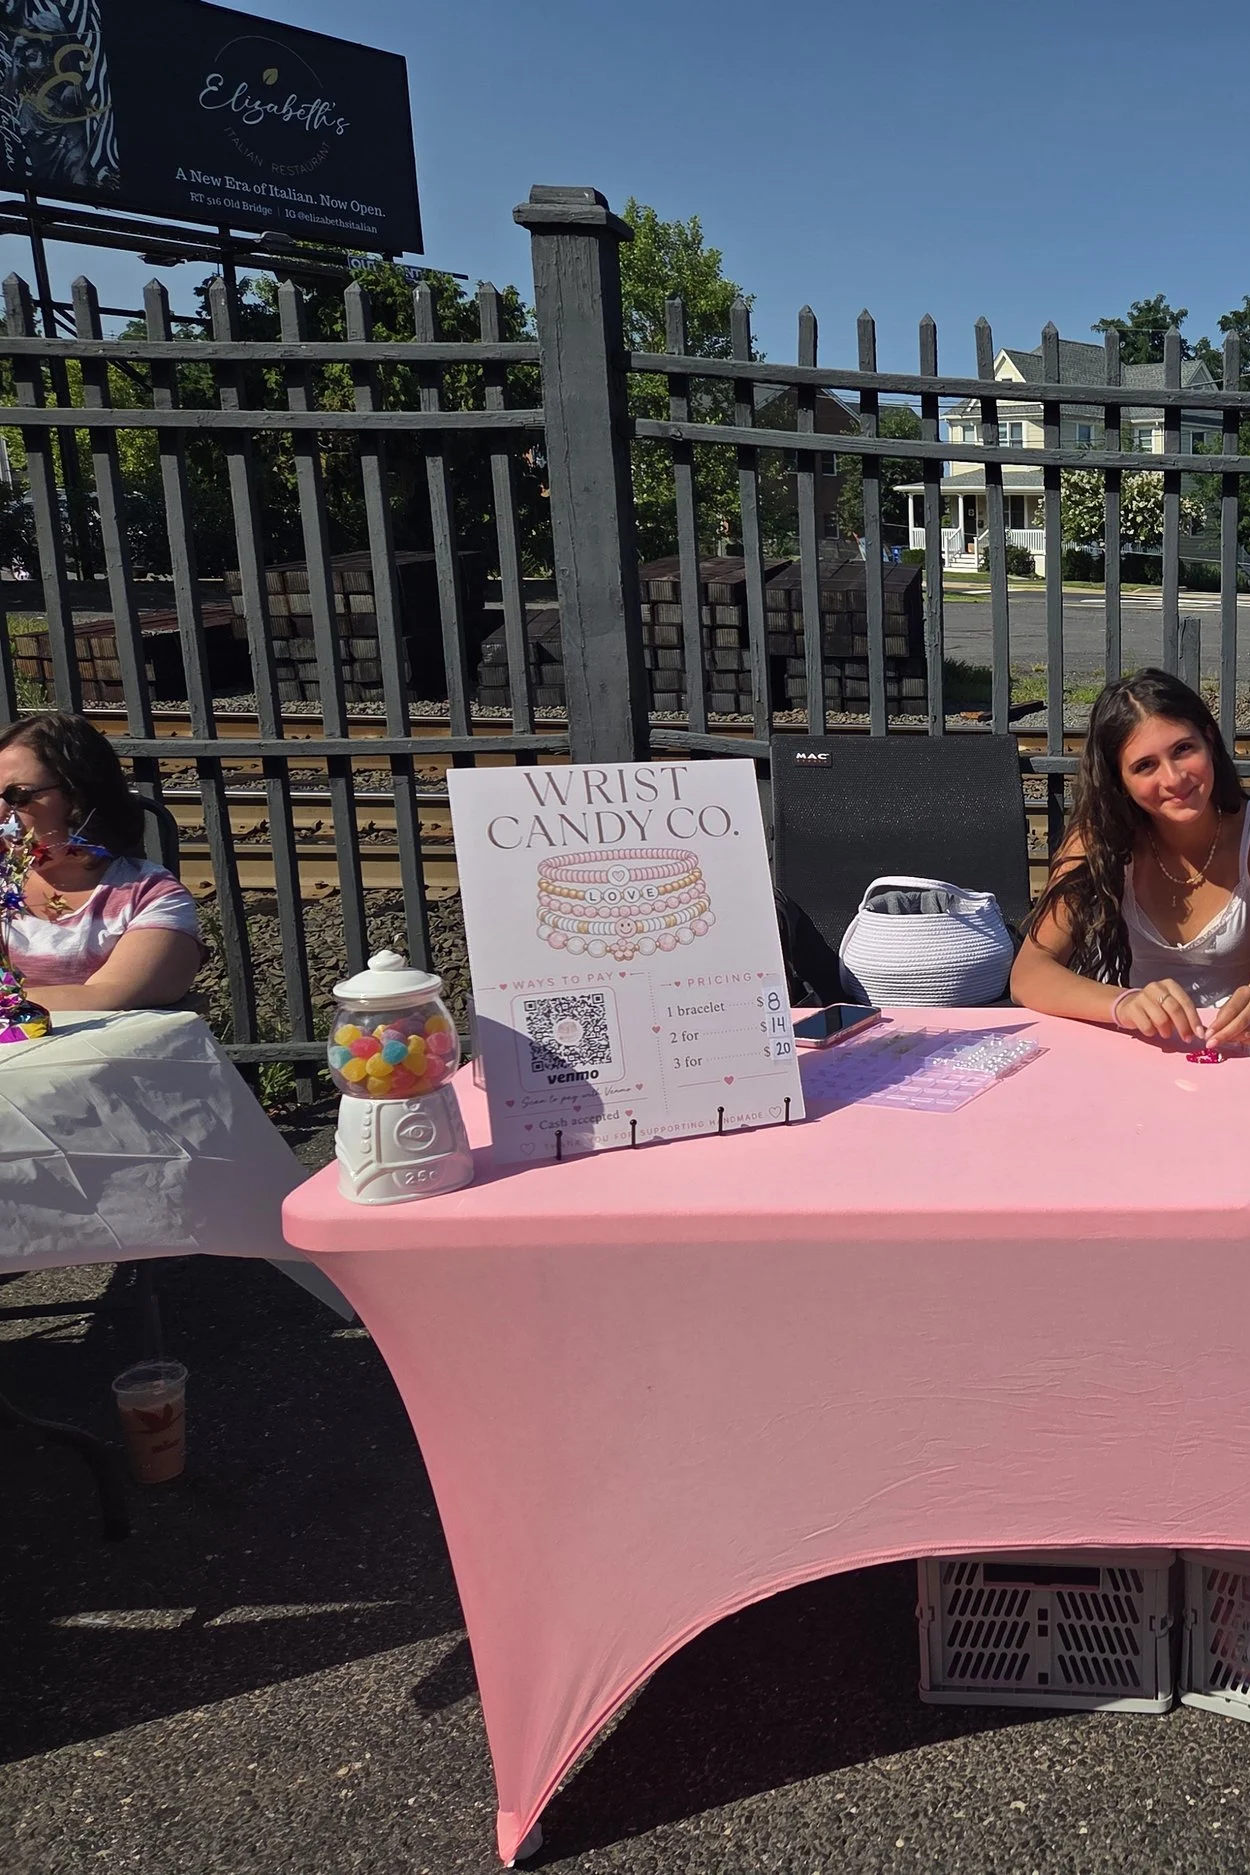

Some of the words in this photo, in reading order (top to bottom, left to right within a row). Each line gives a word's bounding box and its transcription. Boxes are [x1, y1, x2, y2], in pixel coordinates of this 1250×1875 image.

[199, 73, 351, 135] Elizabeth's
[224, 125, 264, 167] ITALIAN
[271, 141, 331, 176] RESTAURANT
[175, 167, 188, 181] A
[190, 169, 222, 187] New
[224, 175, 251, 192] Era
[253, 183, 268, 196] of
[268, 184, 318, 205] Italian.
[319, 194, 348, 210] Now
[350, 200, 386, 217] Open.
[190, 191, 205, 203] RT
[206, 196, 222, 207] 516
[223, 198, 240, 210] Old
[242, 201, 273, 216] Bridge
[284, 208, 297, 219] IG
[297, 211, 378, 234] @elizabethsitalian
[796, 752, 830, 760] MAC
[523, 766, 688, 807] WRIST
[487, 809, 654, 850] CANDY
[666, 805, 740, 839] CO.
[588, 886, 656, 902] LOVE
[512, 977, 555, 990] WAYS
[561, 975, 580, 985] TO
[587, 972, 614, 983] PAY
[687, 972, 752, 988] PRICING
[667, 1006, 673, 1018] 1
[677, 1002, 726, 1017] bracelet
[670, 1032, 678, 1044] 2
[681, 1030, 700, 1042] for
[674, 1057, 681, 1069] 3
[685, 1056, 703, 1068] for
[547, 1068, 600, 1084] venmo
[539, 1117, 568, 1130] Cash
[571, 1110, 620, 1126] accepted
[587, 1134, 609, 1144] YOU
[640, 1120, 704, 1137] SUPPORTING
